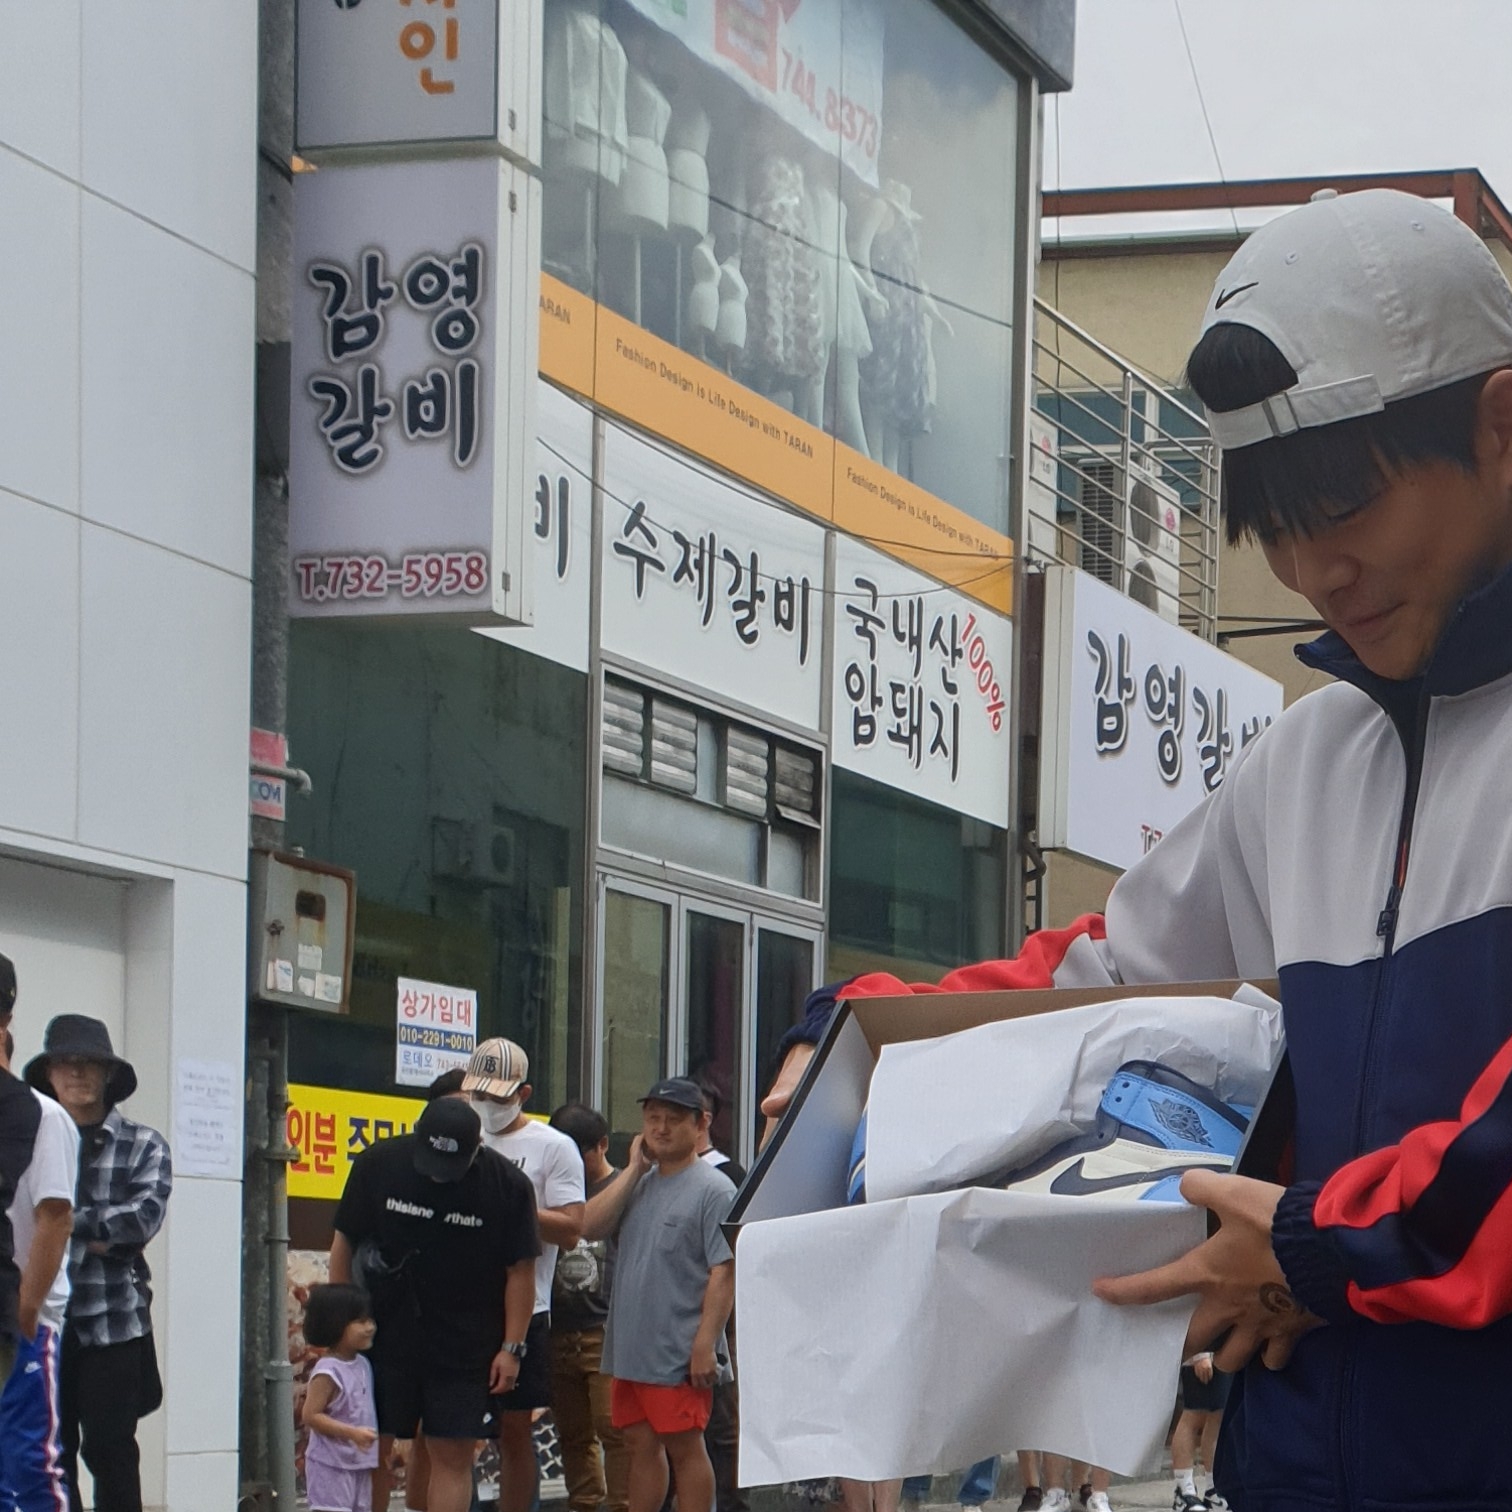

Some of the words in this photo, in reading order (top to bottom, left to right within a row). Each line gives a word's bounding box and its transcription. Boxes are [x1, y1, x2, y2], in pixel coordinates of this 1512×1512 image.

[399, 0, 459, 95] 인
[309, 245, 482, 360] 감영
[309, 362, 479, 470] 갈비
[615, 338, 657, 373] Fashion
[659, 362, 694, 395] Design
[696, 382, 706, 400] is
[708, 389, 726, 411] Life
[728, 400, 760, 432] Design
[761, 420, 781, 441] with
[784, 431, 814, 459] TARAN
[847, 467, 878, 495] Fashion
[880, 486, 907, 510] Design
[916, 507, 931, 525] Life
[932, 515, 957, 539] Design
[958, 530, 974, 547] with
[297, 553, 487, 599] T.732-5958
[612, 501, 811, 667] 수제갈비
[845, 576, 965, 696] 국내산
[961, 612, 1007, 733] 100%
[844, 661, 962, 784] 암돼지
[1087, 629, 1272, 793] 감영갈
[402, 989, 472, 1028] 상가임대
[403, 1050, 433, 1068] 로데오
